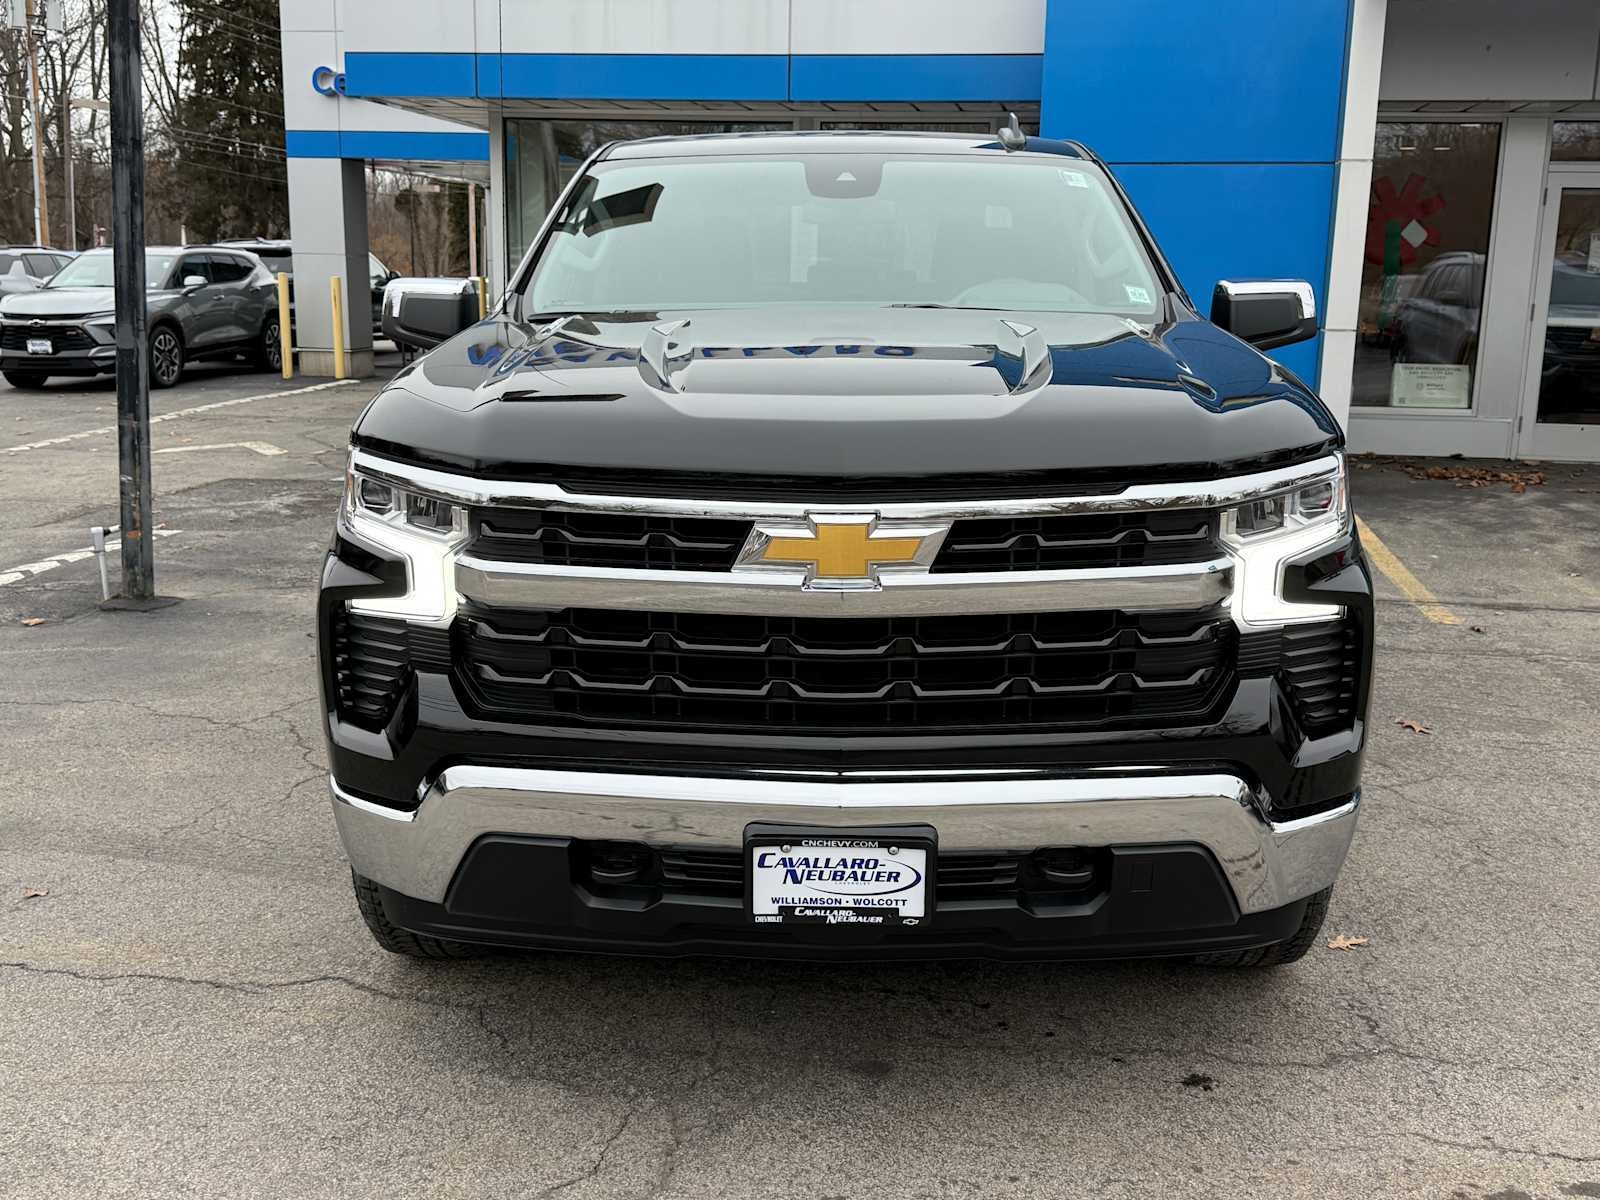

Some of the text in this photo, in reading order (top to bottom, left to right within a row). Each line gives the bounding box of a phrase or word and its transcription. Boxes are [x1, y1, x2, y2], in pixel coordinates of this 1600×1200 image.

[801, 839, 879, 849] CNCHEVY.COM
[782, 868, 901, 885] NEUBAUER
[771, 896, 908, 907] WILLIAMSON WOLCOTT
[826, 914, 884, 924] NEUBAUER
